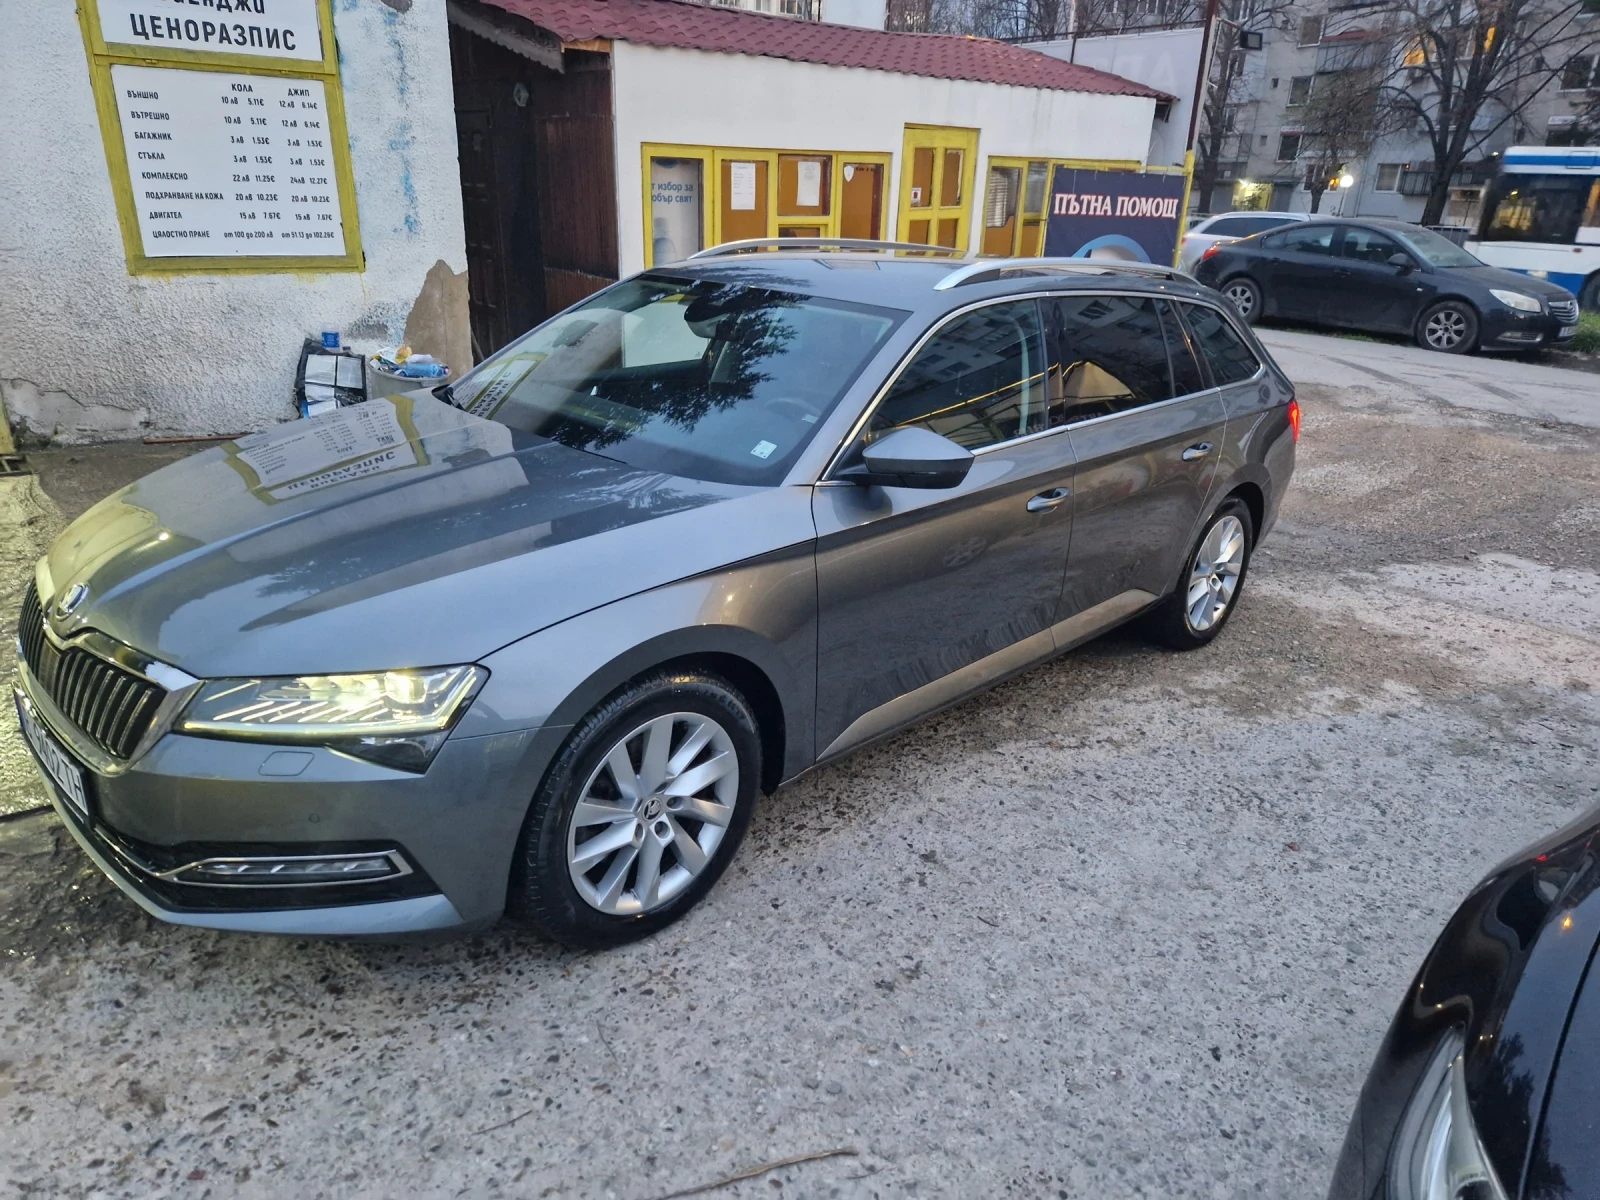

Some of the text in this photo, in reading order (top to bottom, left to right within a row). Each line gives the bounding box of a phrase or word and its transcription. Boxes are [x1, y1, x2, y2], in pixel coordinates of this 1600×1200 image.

[130, 13, 296, 51] ЦЕНОРАЗПИС
[231, 83, 310, 97] КОЛА ДЖИП
[127, 90, 159, 100] ВЪНШНО
[221, 96, 229, 104] 10
[247, 97, 265, 106] 5.11€
[279, 100, 286, 108] 12
[301, 101, 318, 110] 6.14€
[131, 111, 170, 120] ВЪТРЕШНО
[224, 116, 232, 124] 10
[250, 117, 267, 126] 5.11€
[304, 121, 320, 129] 6.14€
[134, 131, 172, 140] БАГАЖНИК
[252, 137, 270, 145] 1.53€
[307, 140, 323, 148] 1.53€
[138, 152, 165, 160] СТЪКЛА
[233, 155, 238, 163] 3
[255, 156, 273, 164] 1.53€
[141, 172, 188, 180] КОМПЛЕКСНО
[232, 174, 241, 182] 22
[255, 175, 275, 183] 11.25€
[658, 181, 682, 193] избор
[684, 184, 694, 192] за
[145, 191, 194, 200] ПОДХРАНВАНЕ
[195, 192, 205, 200] НА
[205, 192, 224, 200] КОЖА
[235, 193, 243, 201] 20
[311, 195, 330, 203] 10.23€
[675, 195, 693, 203] свят
[1054, 193, 1179, 219] ПЪТНА ПОМОЩ
[149, 211, 182, 220] ДВИГАТЕЛ
[240, 212, 247, 220] 15
[263, 212, 281, 220] 7.67€
[152, 231, 188, 239] ЦЯЛОСТНО
